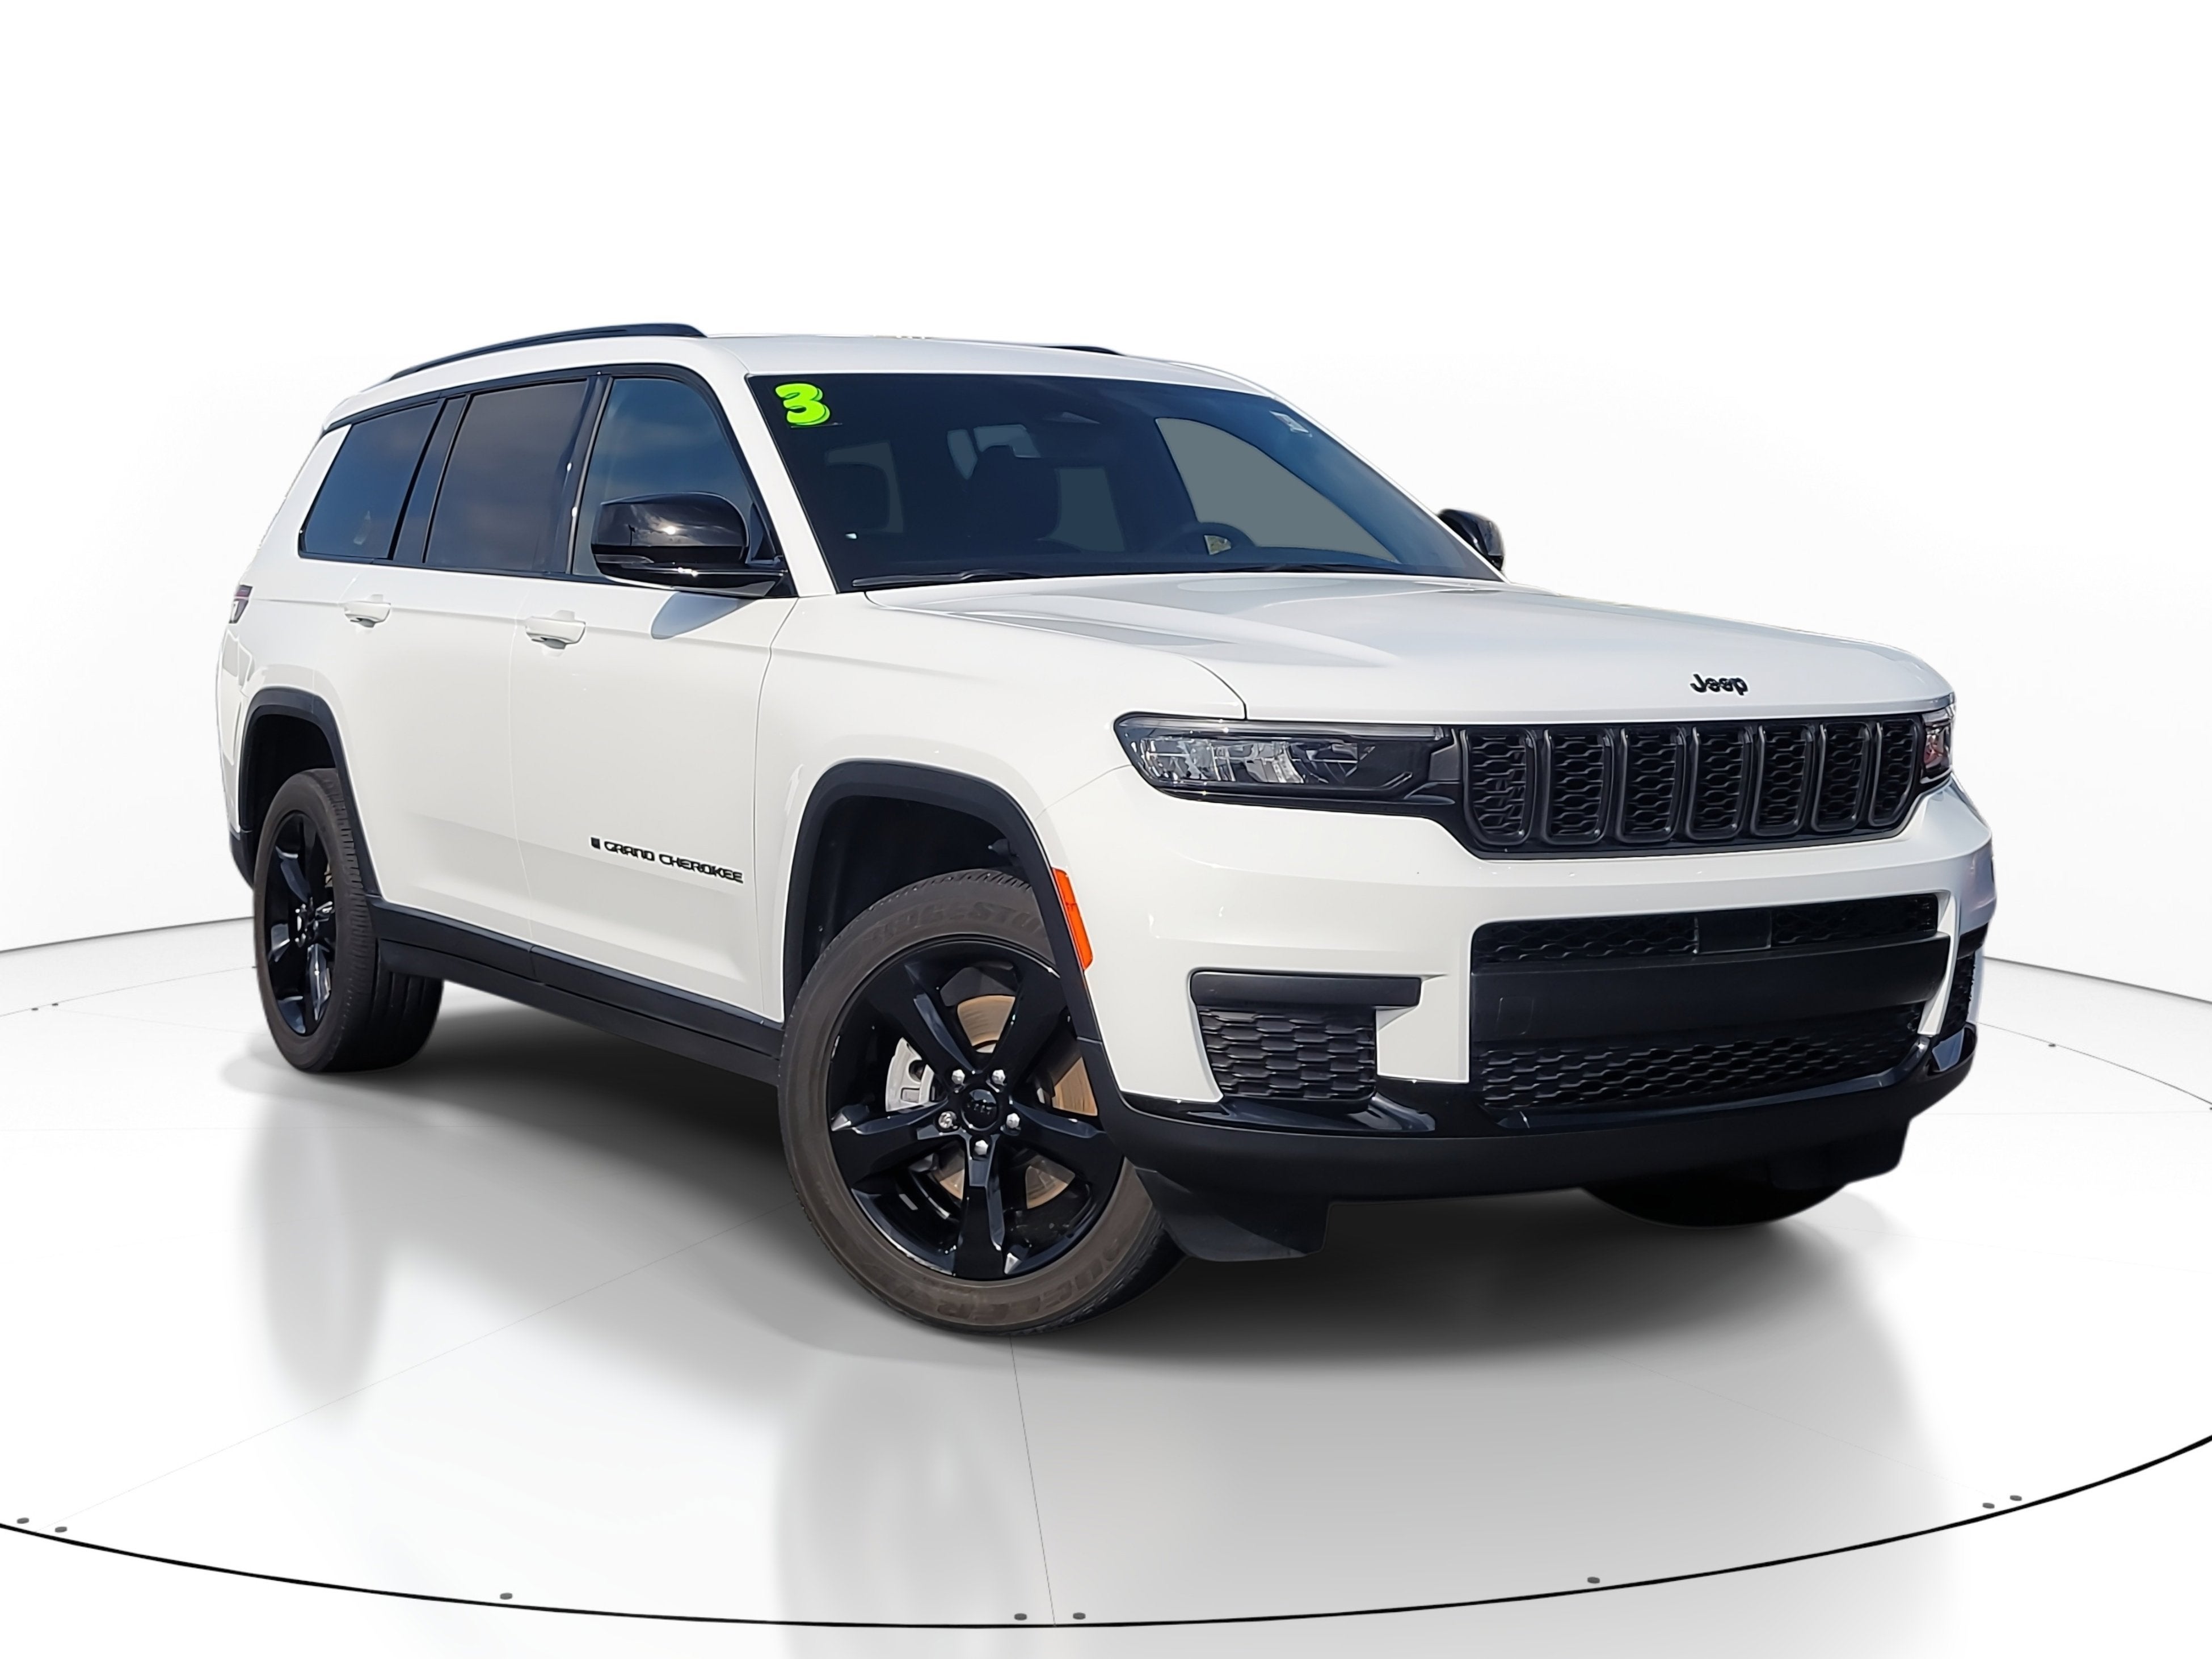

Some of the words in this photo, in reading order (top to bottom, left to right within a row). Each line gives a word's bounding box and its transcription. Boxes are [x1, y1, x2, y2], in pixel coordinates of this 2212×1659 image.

[774, 382, 831, 426] 3
[1689, 673, 1748, 696] Jeep
[604, 841, 655, 862] GRAND
[659, 853, 744, 884] CHEROKEE
